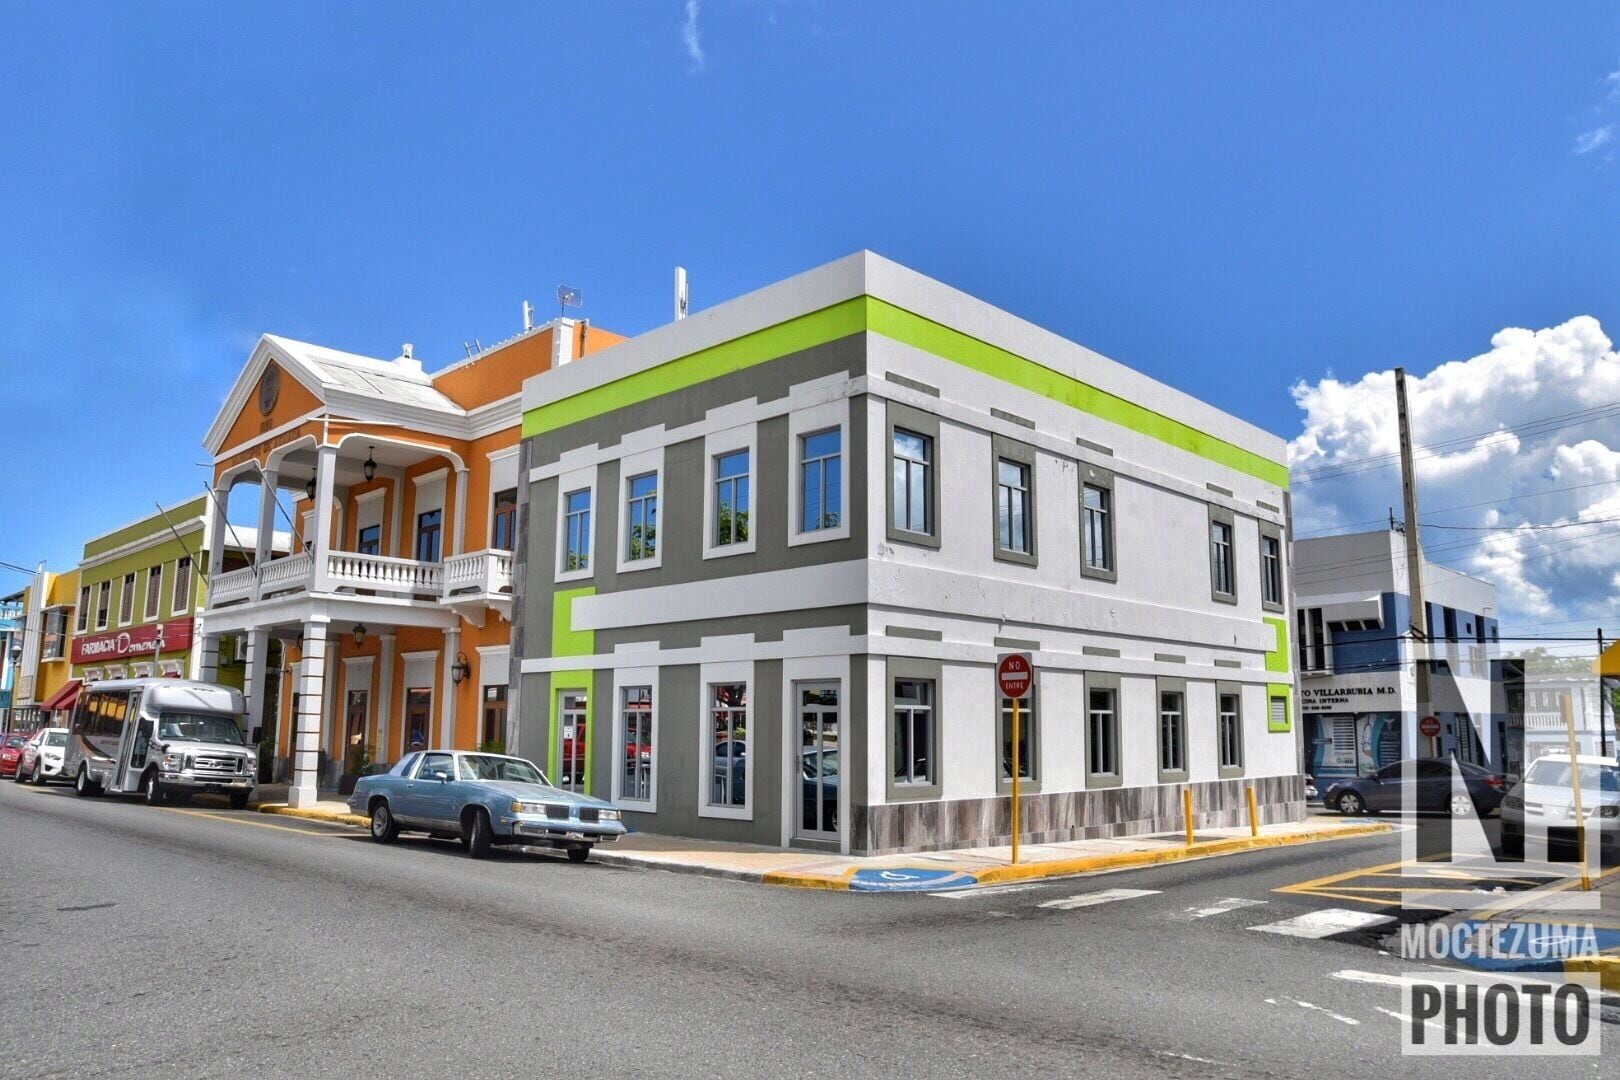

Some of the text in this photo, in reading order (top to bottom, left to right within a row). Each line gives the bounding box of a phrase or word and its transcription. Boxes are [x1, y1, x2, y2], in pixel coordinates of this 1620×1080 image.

[81, 639, 115, 655] FARMACIA
[1008, 661, 1021, 670] NO
[1005, 682, 1024, 690] ENTRE
[1313, 687, 1373, 696] VILLARRUBIA
